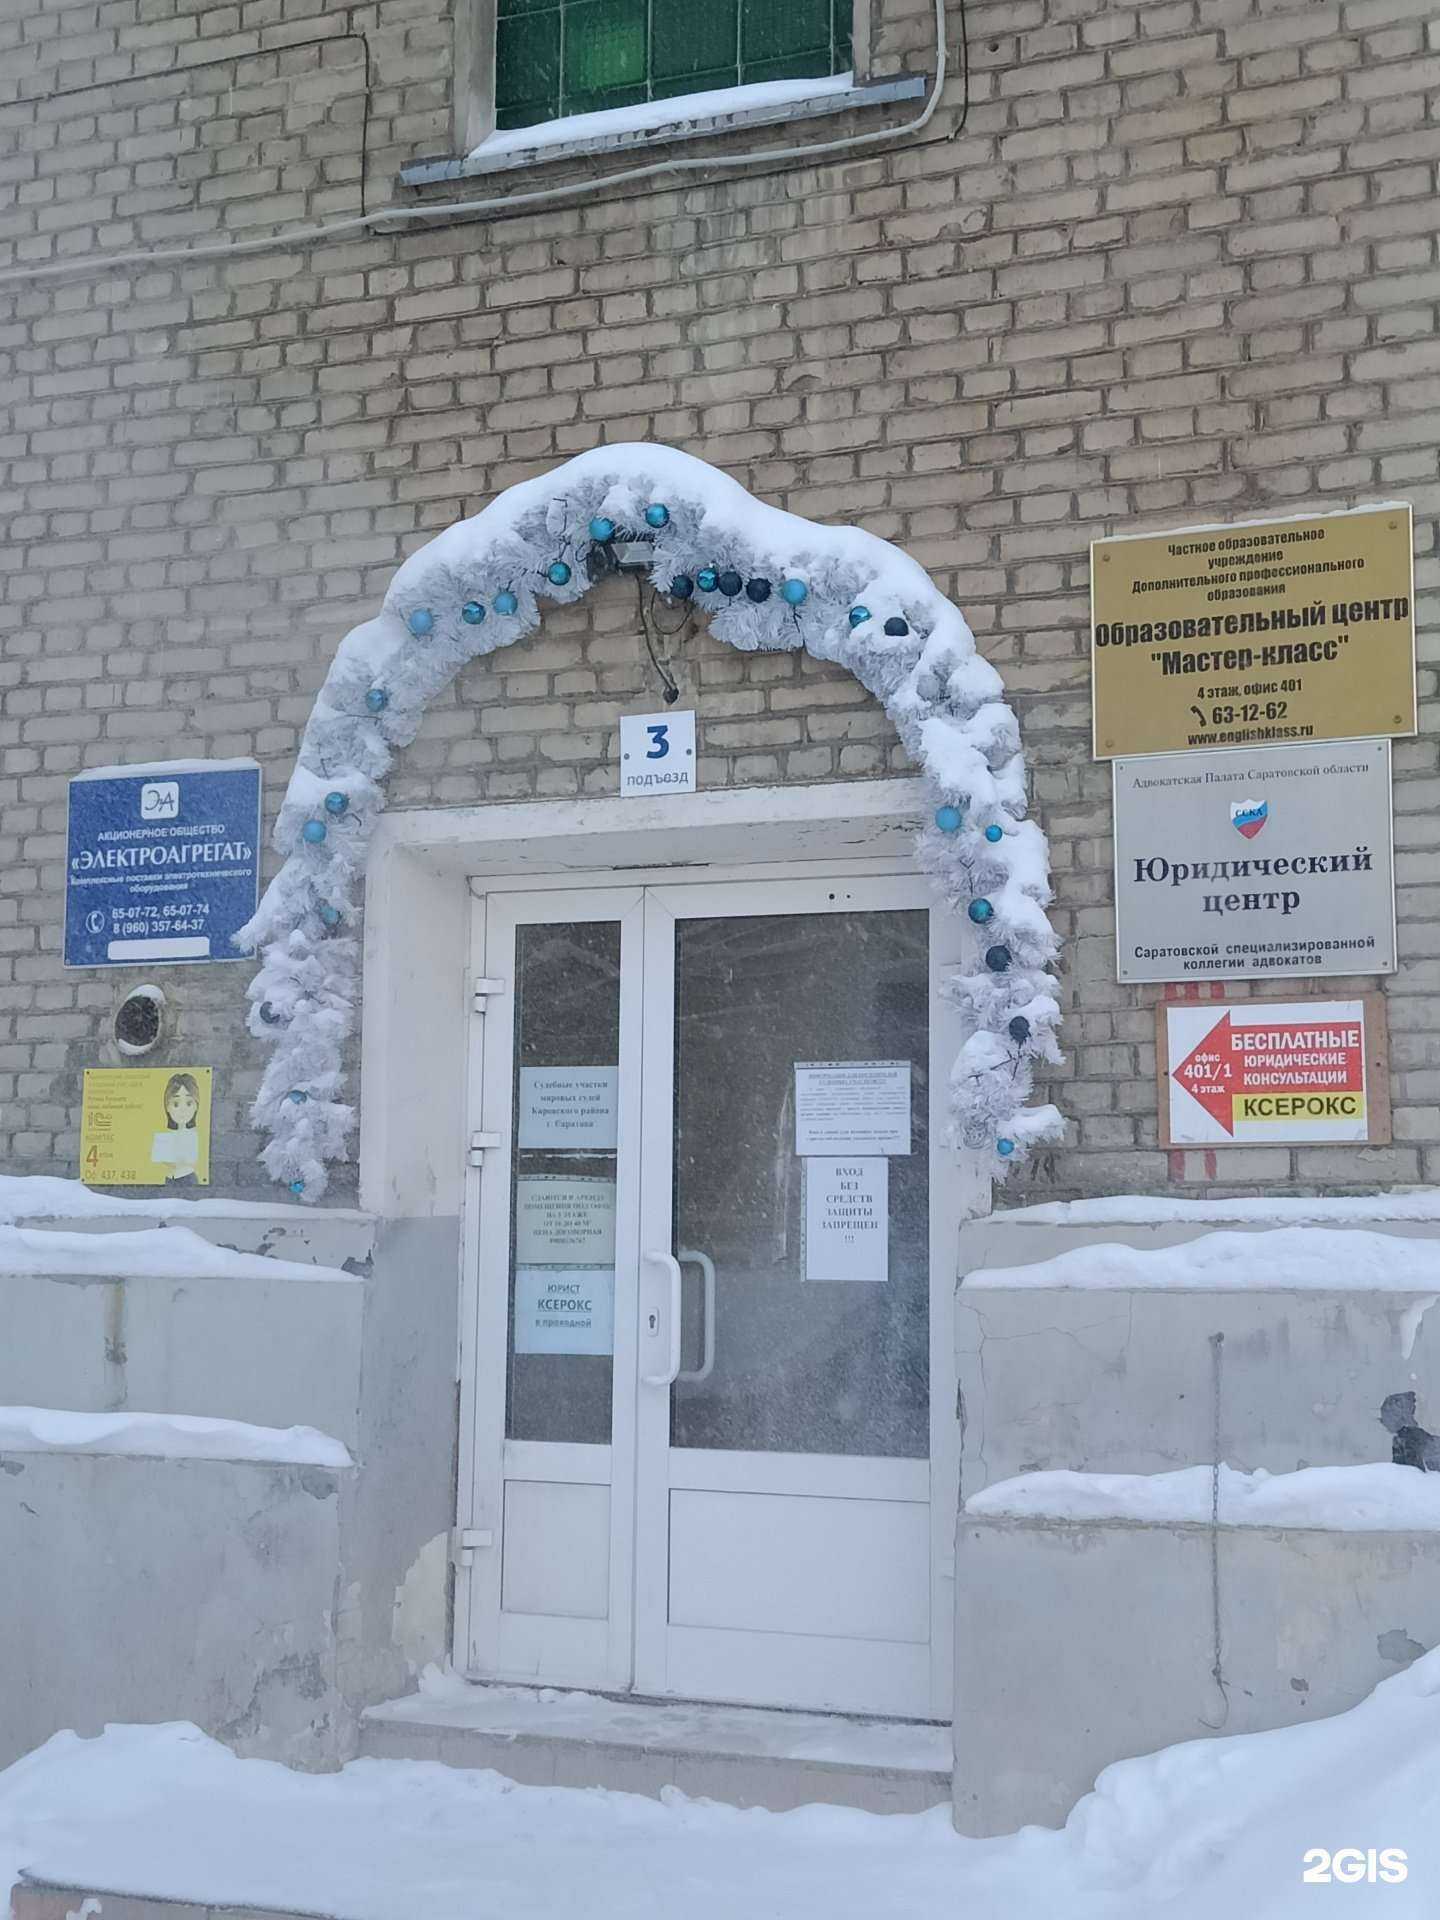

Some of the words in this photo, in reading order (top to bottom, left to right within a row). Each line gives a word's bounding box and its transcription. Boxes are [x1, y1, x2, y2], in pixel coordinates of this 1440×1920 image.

[1168, 538, 1216, 557] Частное
[1218, 528, 1325, 551] образовательное
[1208, 550, 1283, 570] учреждение
[1132, 573, 1237, 594] Дополнительного
[1239, 557, 1365, 581] профессионального
[1207, 584, 1286, 602] образования
[1096, 601, 1326, 647] Образовательный
[1332, 596, 1409, 625] центр
[1151, 634, 1350, 676] "Мастер-класс"
[1197, 686, 1205, 699] 4
[1244, 680, 1278, 697] офис
[1280, 678, 1302, 693] 401
[1212, 701, 1288, 725] 63-12-62
[646, 725, 670, 759] 3
[1188, 725, 1314, 746] www.englishklass.ru
[627, 771, 689, 787] подъезд
[1133, 775, 1202, 790] Адвокатская
[1205, 771, 1245, 784] Палата
[1248, 766, 1320, 783] Саратовской
[1323, 762, 1369, 776] области
[97, 827, 167, 842] АКЦИОНЕРНОЕ
[169, 824, 225, 838] ОБЩЕСТВО
[71, 841, 252, 870] «ЭЛЕКТРОАГРЕГАТ»
[126, 873, 163, 882] поставки
[164, 868, 252, 882] электротехнического
[1133, 846, 1373, 887] Юридический
[129, 883, 188, 895] оборудования
[112, 906, 160, 920] 65-07-72,
[163, 903, 210, 917] 65-07-74
[1203, 890, 1301, 916] центр
[113, 924, 119, 934] 8
[122, 921, 150, 936] (960)
[152, 919, 205, 932] 357-64-37
[1134, 943, 1219, 960] Саратовской
[1226, 936, 1375, 956] специализированной
[1183, 957, 1245, 971] коллегии
[1252, 953, 1322, 968] адвокатов
[1231, 1029, 1360, 1051] БЕСПЛАТНЫЕ
[1195, 1053, 1221, 1064] офис
[1244, 1052, 1347, 1068] ЮРИДИЧЕСКИЕ
[1184, 1063, 1233, 1081] 401/1
[1243, 1070, 1348, 1086] КОНСУЛЬТАЦИИ
[534, 1079, 572, 1090] Судебные
[575, 1080, 608, 1089] участки
[1191, 1084, 1199, 1093] 4
[1199, 1084, 1225, 1094] этаж
[540, 1095, 576, 1103] мировых
[578, 1093, 601, 1103] судей
[1244, 1096, 1357, 1117] КСЕРОКС
[580, 1106, 609, 1116] района
[554, 1119, 594, 1129] Саратова
[86, 1144, 99, 1168] 4
[835, 1168, 863, 1177] ВХОД
[840, 1181, 859, 1190] БЕЗ
[826, 1194, 873, 1204] СРЕДСТВ
[827, 1207, 873, 1217] ЗАЩИТЫ
[822, 1220, 878, 1231] ЗАПРЕЩЕН
[547, 1284, 580, 1294] ЮРИСТ
[537, 1299, 592, 1310] КСЕРОКС
